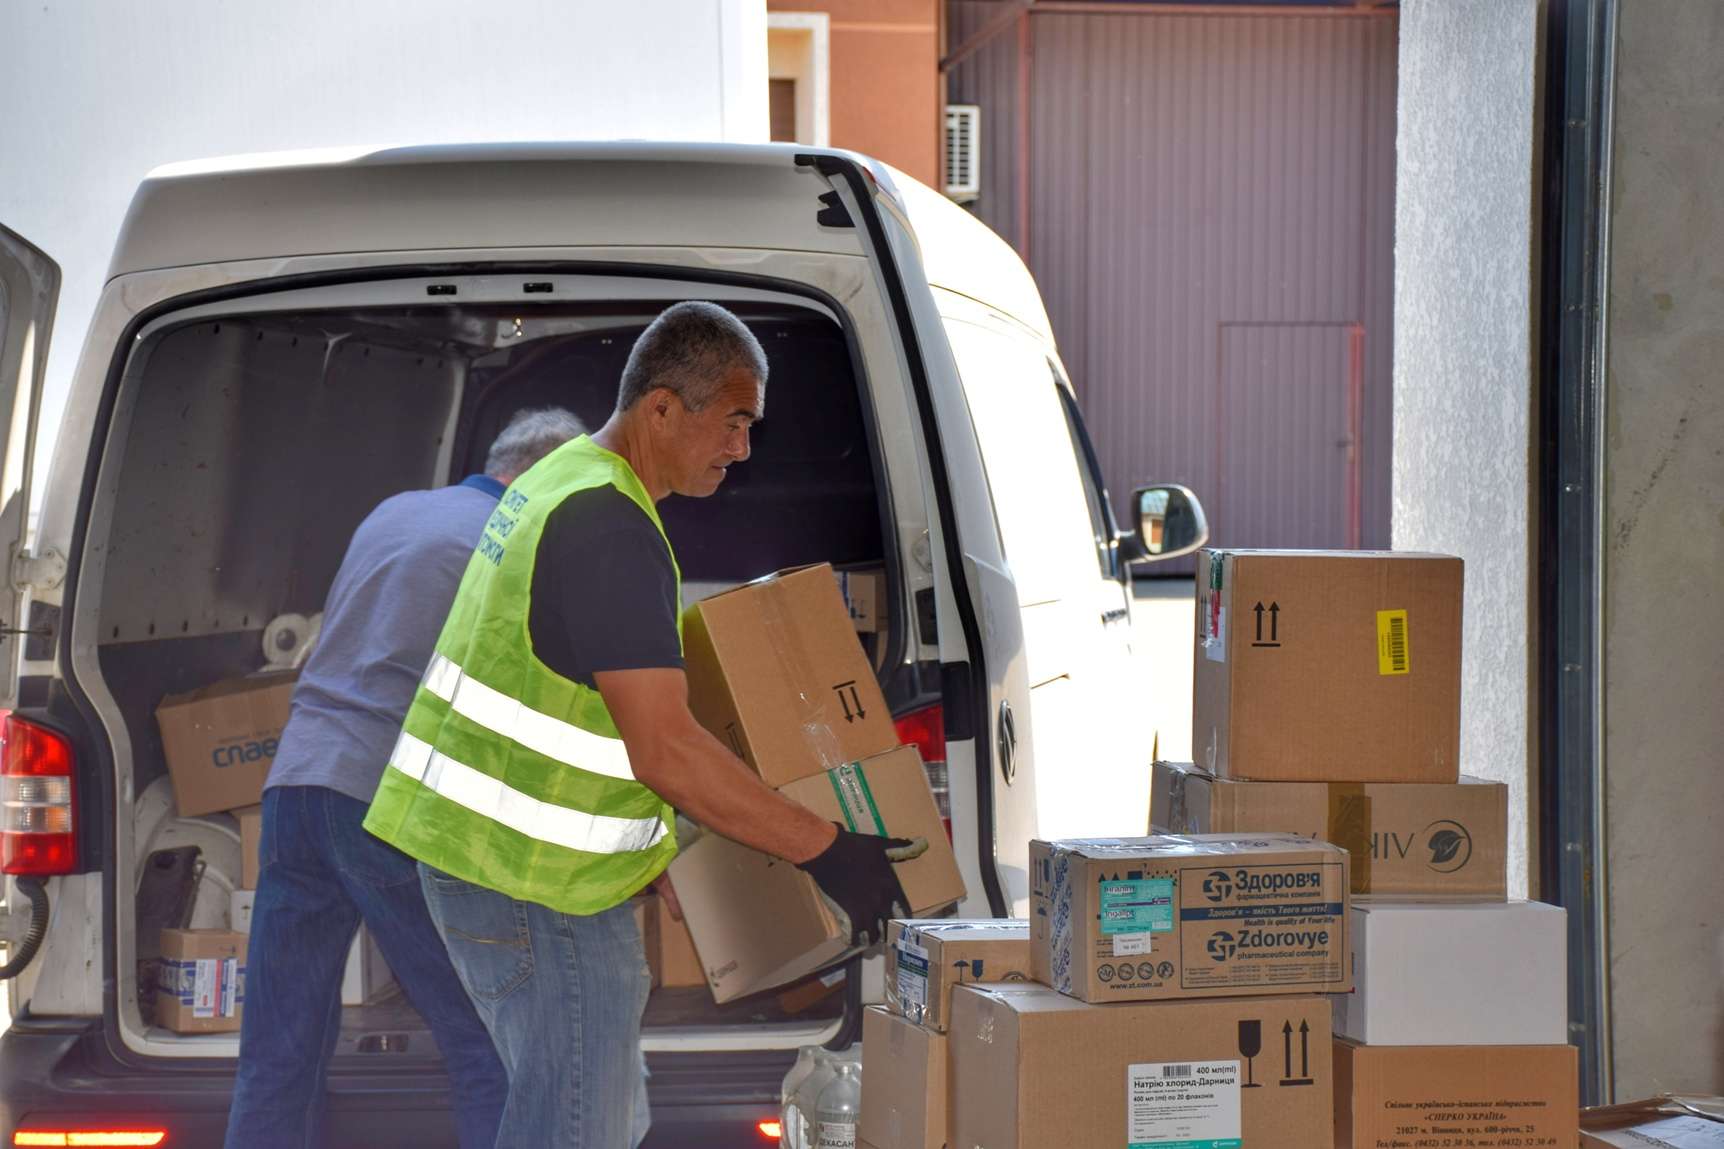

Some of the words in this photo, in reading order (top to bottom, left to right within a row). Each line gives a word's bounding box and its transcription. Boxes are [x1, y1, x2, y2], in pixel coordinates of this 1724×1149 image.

[1235, 870, 1321, 892] Здоров'я
[1244, 918, 1265, 927] Health
[1267, 918, 1274, 926] is
[1276, 917, 1297, 927] quality
[1299, 917, 1306, 925] of
[1237, 929, 1328, 949] Zdorovye
[1237, 950, 1295, 961] pharmaceutical
[1296, 949, 1329, 959] company
[1110, 981, 1163, 990] www.zt.com.ua
[1196, 1066, 1209, 1074] 400
[1134, 1079, 1164, 1089] Натрію
[1166, 1077, 1235, 1089] хлорид-Дарниця
[1185, 1093, 1215, 1102] флаконів
[1396, 1126, 1419, 1135] 21027
[1525, 1125, 1535, 1133] 25
[1415, 1139, 1440, 1148] (0432)
[1497, 1138, 1522, 1148] (0432)
